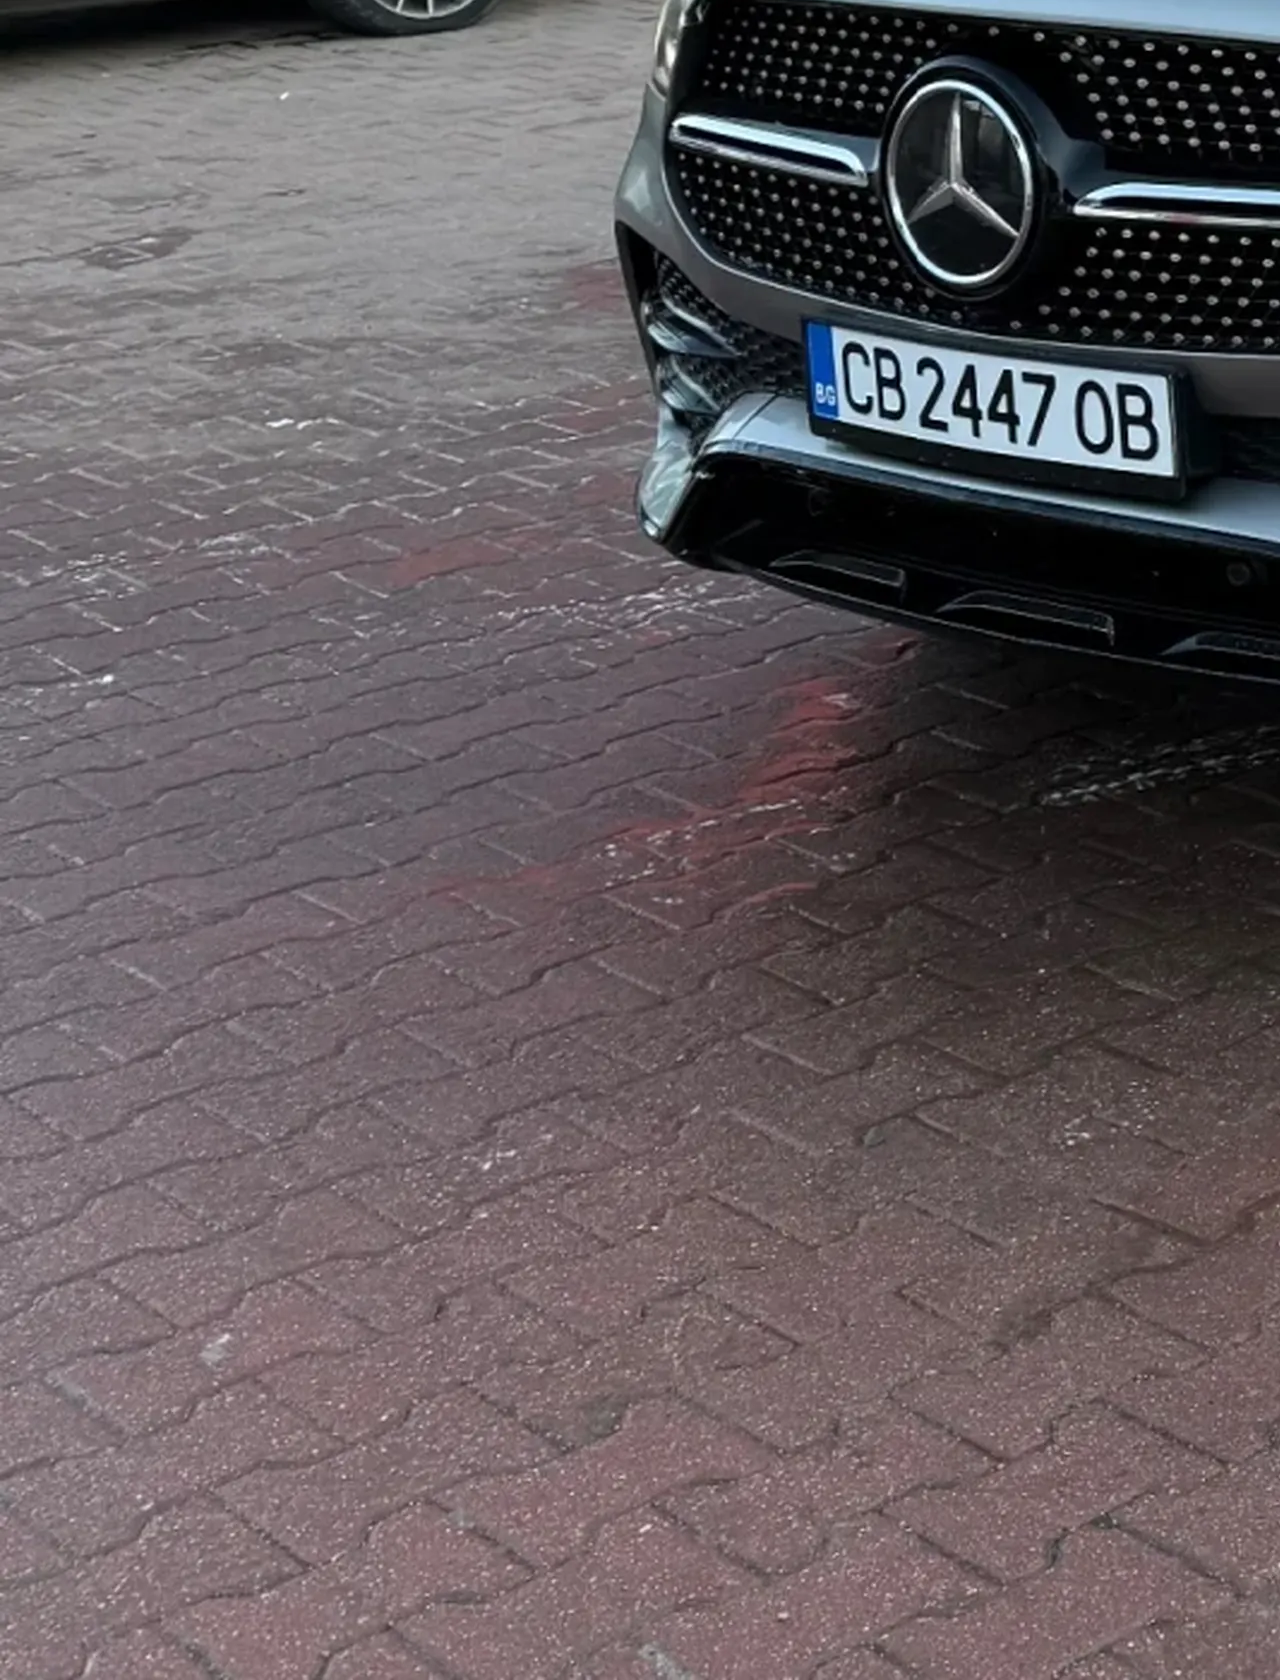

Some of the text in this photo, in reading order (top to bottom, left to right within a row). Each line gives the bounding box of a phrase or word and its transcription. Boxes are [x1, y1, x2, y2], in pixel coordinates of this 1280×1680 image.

[815, 381, 837, 407] BG
[841, 340, 1160, 461] CB 2447 OB
